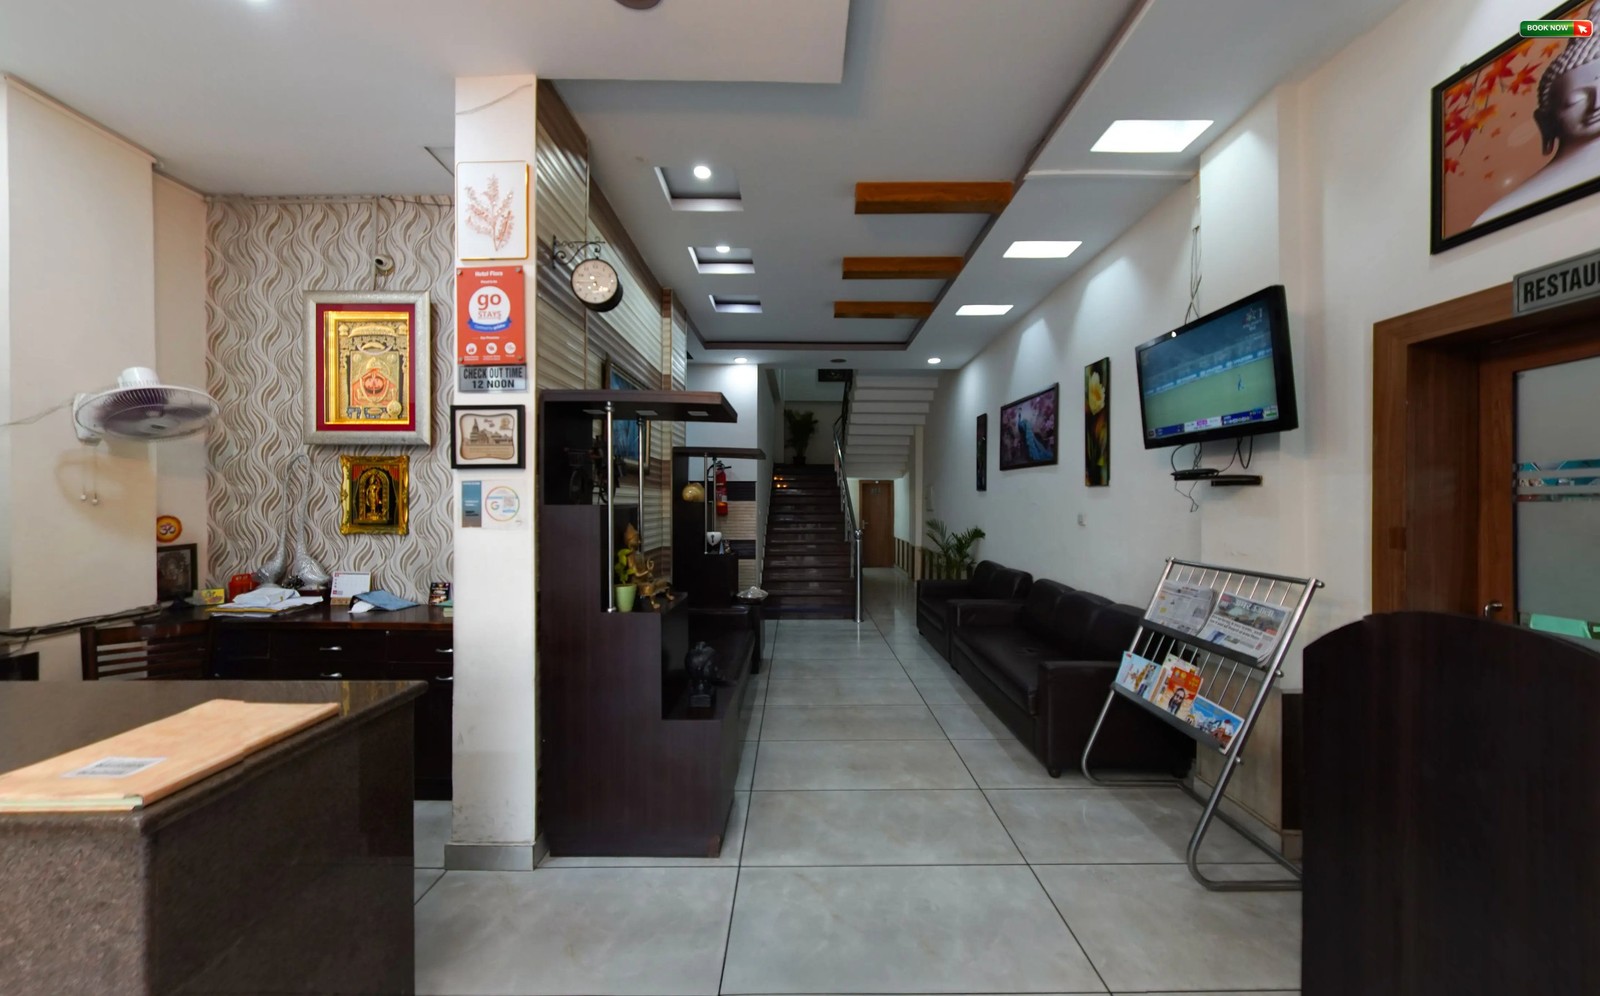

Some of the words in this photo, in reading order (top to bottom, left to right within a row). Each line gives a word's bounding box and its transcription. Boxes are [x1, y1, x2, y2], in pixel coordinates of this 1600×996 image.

[477, 293, 502, 310] go
[463, 368, 488, 380] CHECK
[488, 367, 503, 379] OUT
[504, 366, 523, 379] TIME
[472, 380, 484, 389] 12
[486, 379, 515, 389] NOON
